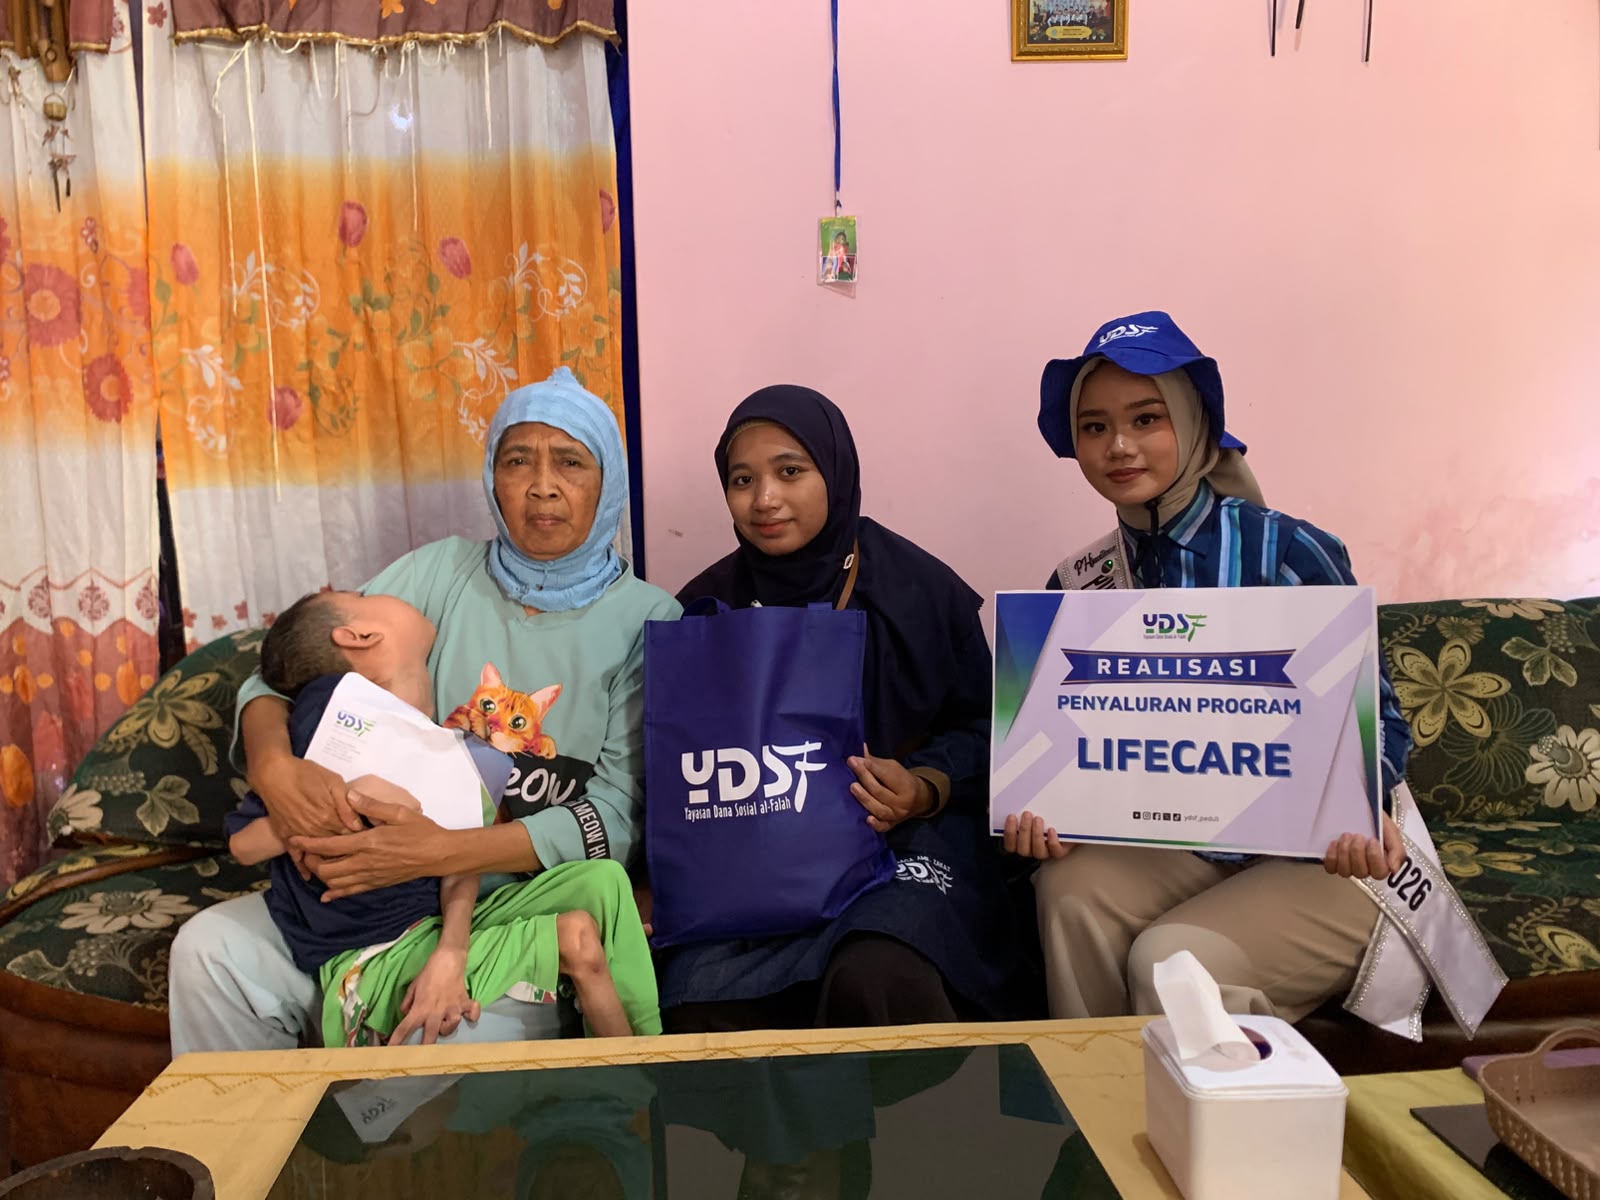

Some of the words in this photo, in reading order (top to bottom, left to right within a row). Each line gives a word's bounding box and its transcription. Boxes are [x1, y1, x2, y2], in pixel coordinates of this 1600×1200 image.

[1143, 613, 1207, 642] YDSF
[1097, 658, 1257, 677] REALISASI
[1057, 694, 1192, 713] PENYALURAN
[1197, 697, 1301, 715] PROGRAM
[1077, 736, 1292, 777] LIFECARE
[681, 741, 828, 813] YDSF
[573, 803, 604, 844] MEOW
[684, 806, 711, 823] Yayasan
[713, 804, 733, 818] Dana
[735, 802, 757, 817] Sosial
[759, 796, 792, 814] al-Falah
[1387, 855, 1432, 912] 026
